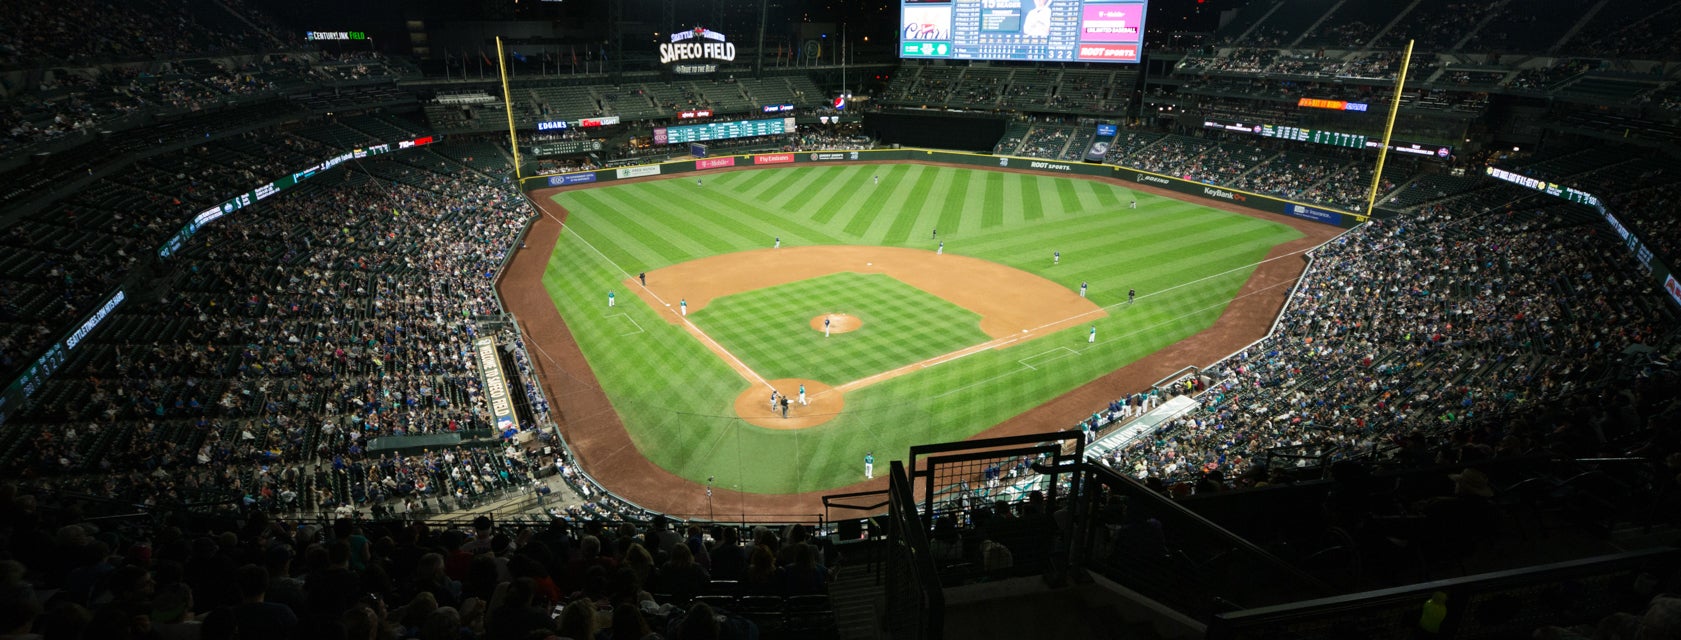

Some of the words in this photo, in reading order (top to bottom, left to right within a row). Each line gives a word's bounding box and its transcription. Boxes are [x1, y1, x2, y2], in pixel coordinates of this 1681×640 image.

[349, 31, 365, 40] FIELD
[660, 43, 702, 64] SAFECO
[704, 42, 735, 61] FIELD
[1080, 47, 1105, 56] ROOT
[1031, 161, 1049, 169] ROOT
[1144, 175, 1170, 184] BOEING
[1204, 187, 1234, 200] KeyBank
[479, 345, 497, 370] WELCOME
[484, 368, 499, 378] TO
[486, 377, 505, 398] SAFECO
[492, 397, 509, 417] FIELD
